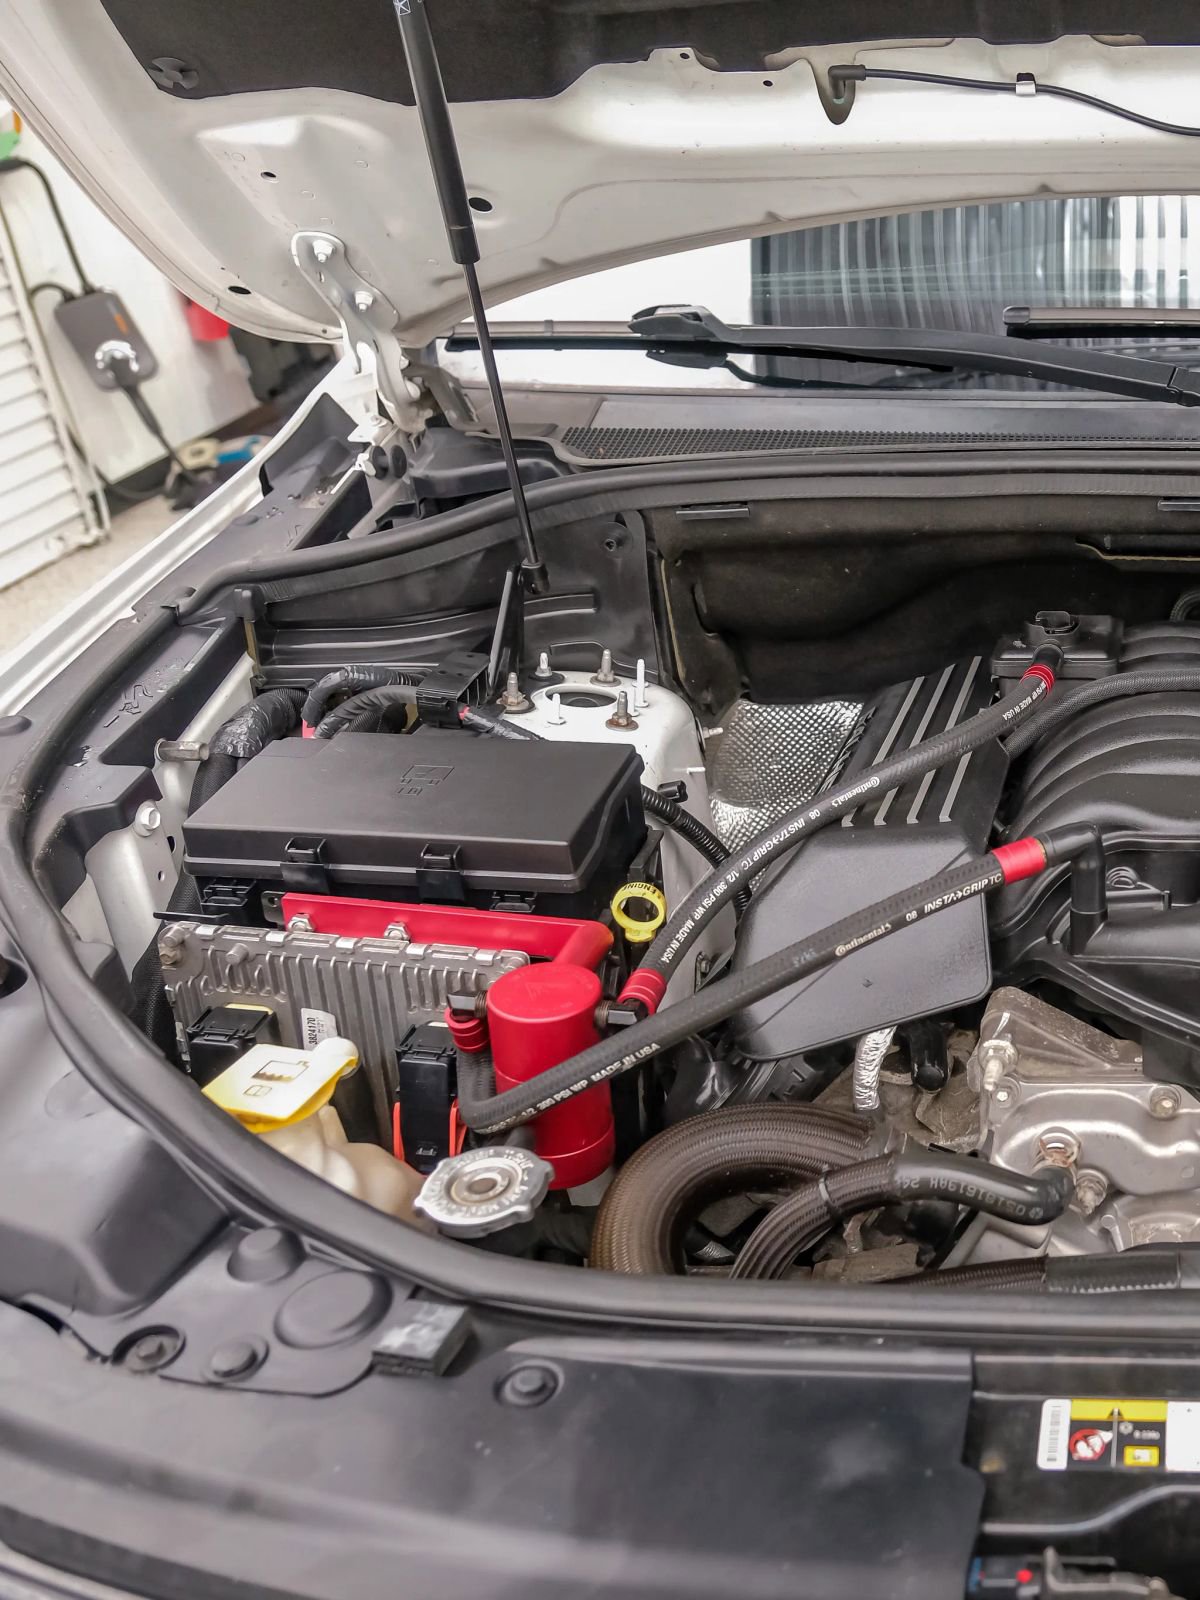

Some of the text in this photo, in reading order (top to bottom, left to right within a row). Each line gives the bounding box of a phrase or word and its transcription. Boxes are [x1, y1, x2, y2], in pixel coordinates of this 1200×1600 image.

[1002, 709, 1015, 721] USA
[837, 776, 880, 806] Continental
[808, 808, 821, 820] 08
[741, 859, 754, 870] TC
[726, 870, 740, 883] 1/2
[712, 881, 728, 896] 300
[701, 893, 717, 909] PSI
[693, 906, 707, 921] WP
[835, 924, 886, 957] Continental
[905, 910, 918, 922] 08
[988, 873, 1002, 885] TC
[674, 918, 695, 943] MADE
[669, 938, 681, 951] IN
[661, 945, 677, 964] USA
[306, 1017, 318, 1045] 3824170
[553, 1089, 573, 1103] PSI
[570, 1079, 589, 1092] WP
[590, 1060, 623, 1082] MADE
[622, 1054, 637, 1068] IN
[635, 1042, 661, 1060] USA
